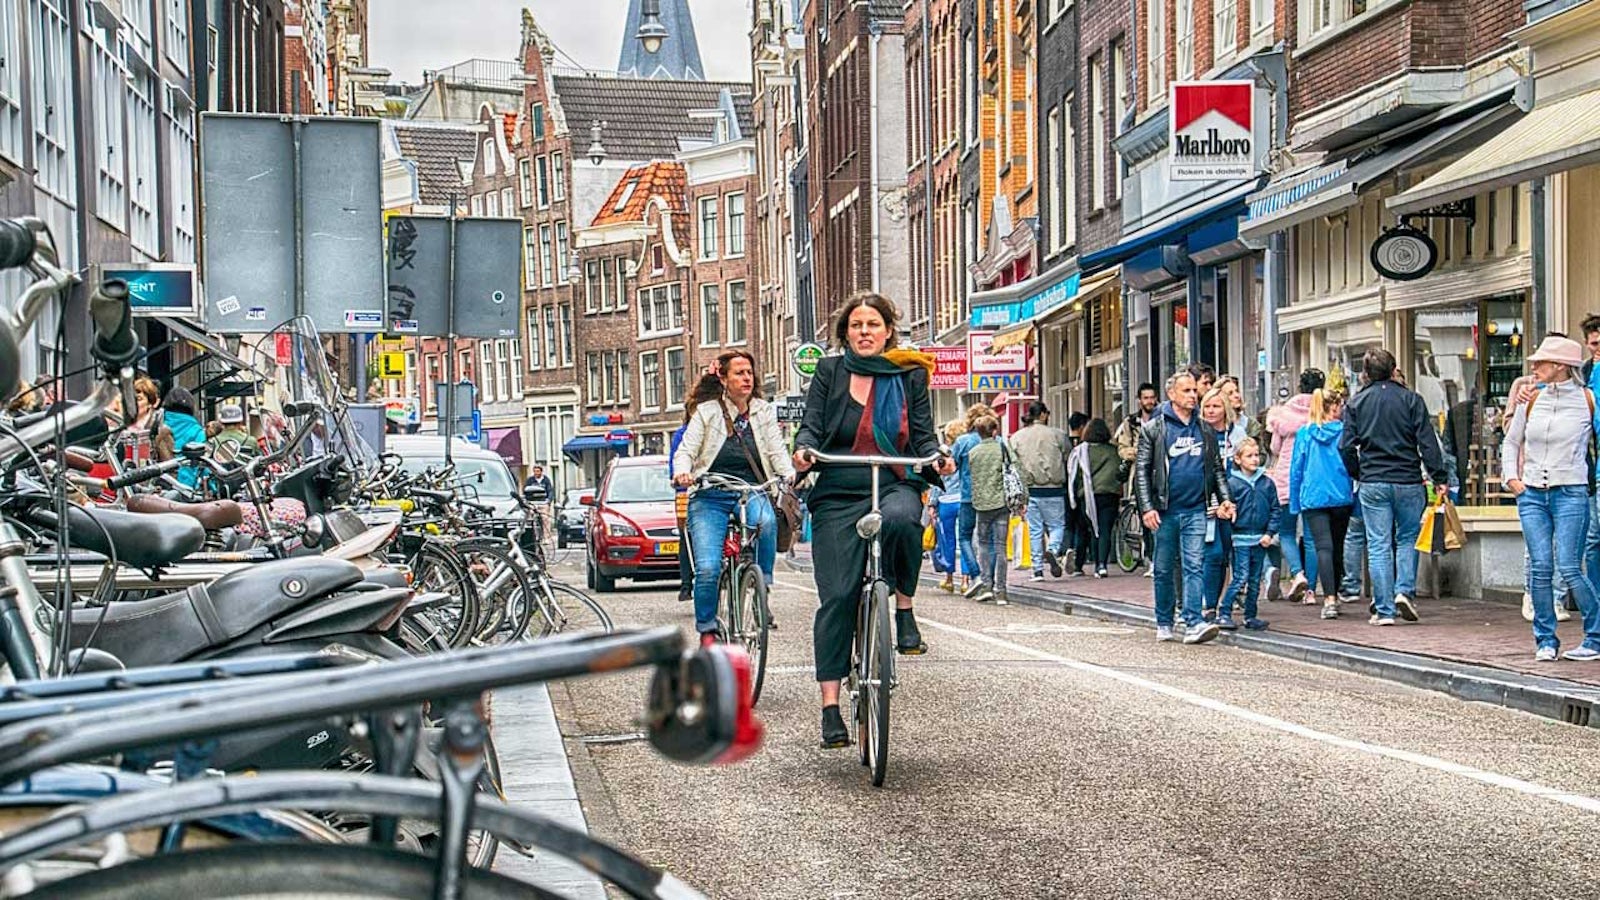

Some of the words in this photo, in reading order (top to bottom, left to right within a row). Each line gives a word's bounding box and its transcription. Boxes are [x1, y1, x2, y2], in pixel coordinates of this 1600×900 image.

[1174, 128, 1250, 156] Marlboro
[1215, 167, 1247, 176] dodelijk
[937, 362, 961, 373] TABAK
[978, 374, 1021, 388] ATM
